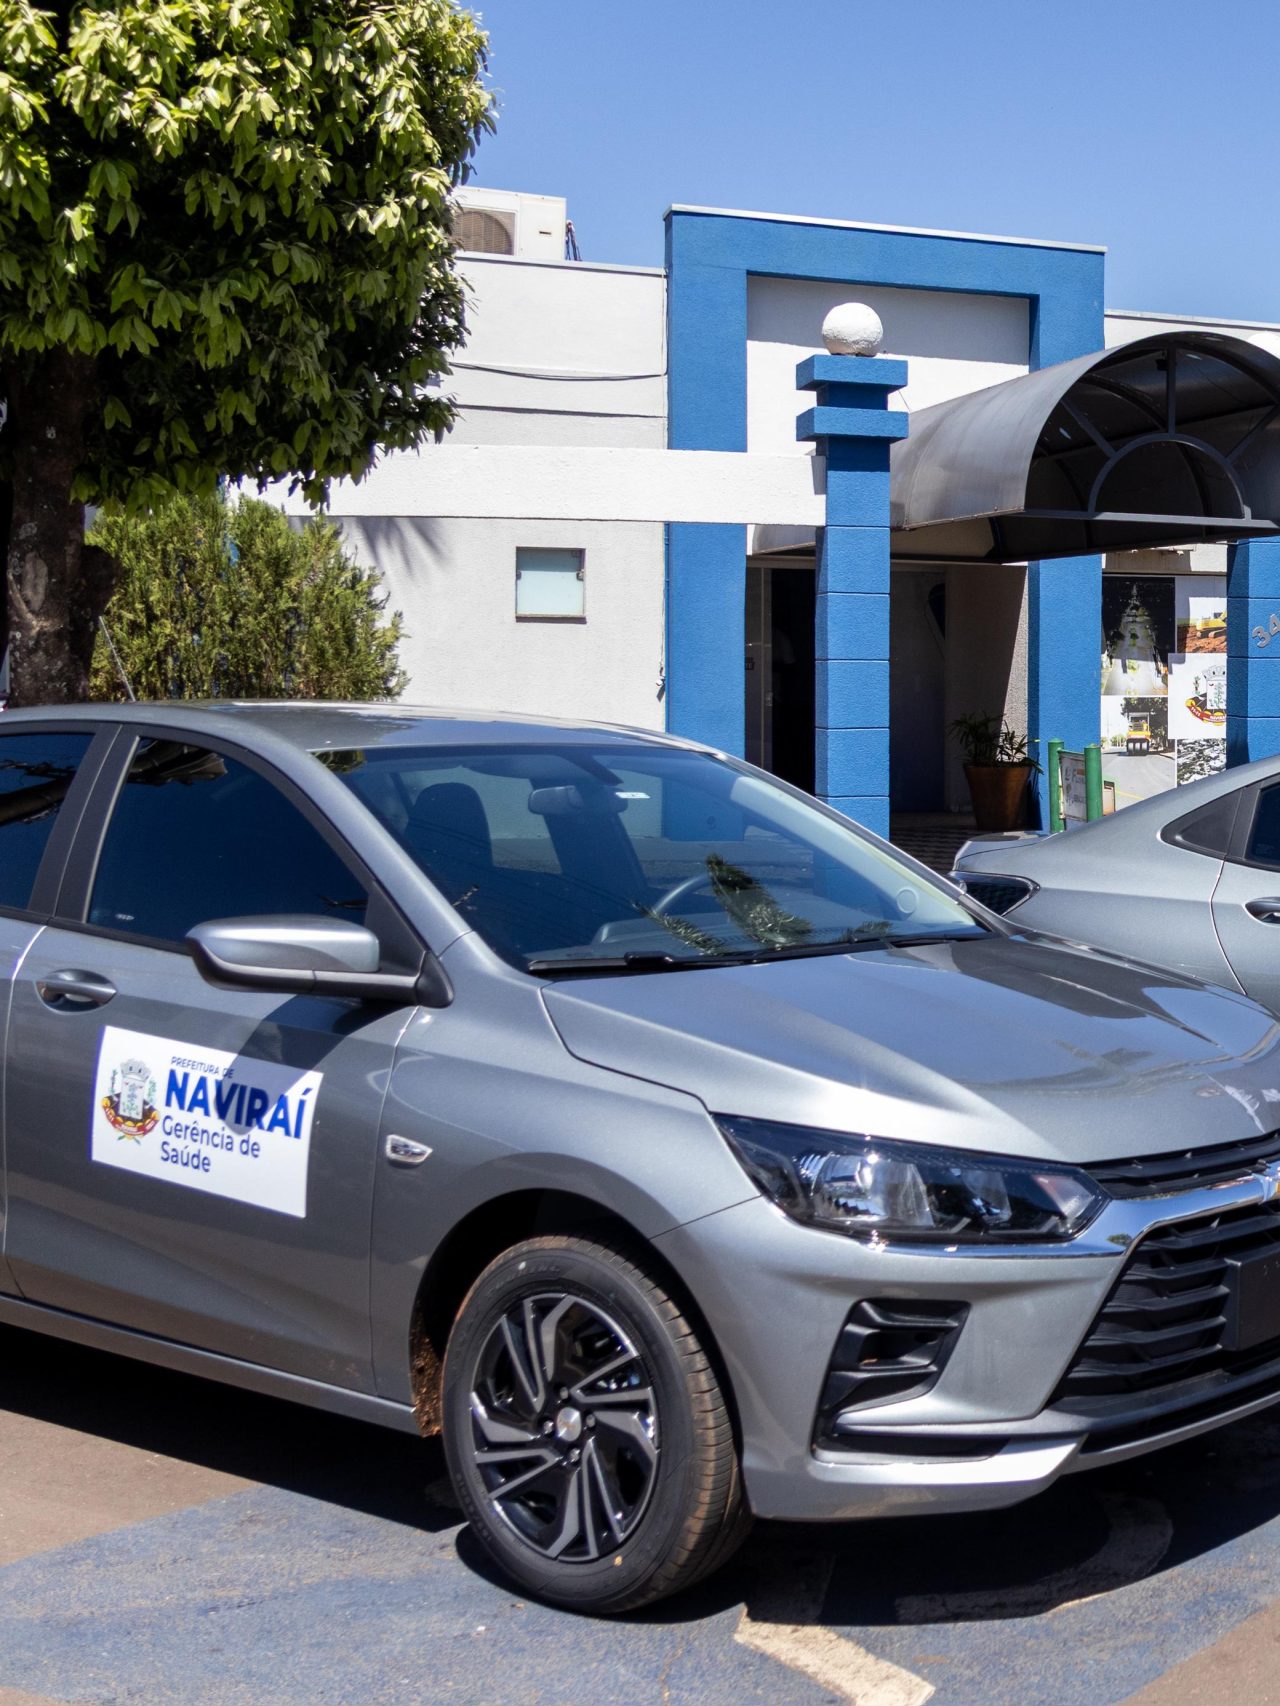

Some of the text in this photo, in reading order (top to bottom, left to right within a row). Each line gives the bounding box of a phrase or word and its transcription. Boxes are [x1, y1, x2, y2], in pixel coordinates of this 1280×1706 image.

[171, 1056, 234, 1079] PREFEITURA DE
[165, 1069, 313, 1139] NAVIRAÍ
[162, 1115, 234, 1152] Gerência
[239, 1134, 261, 1159] de
[160, 1141, 212, 1173] Saúde
